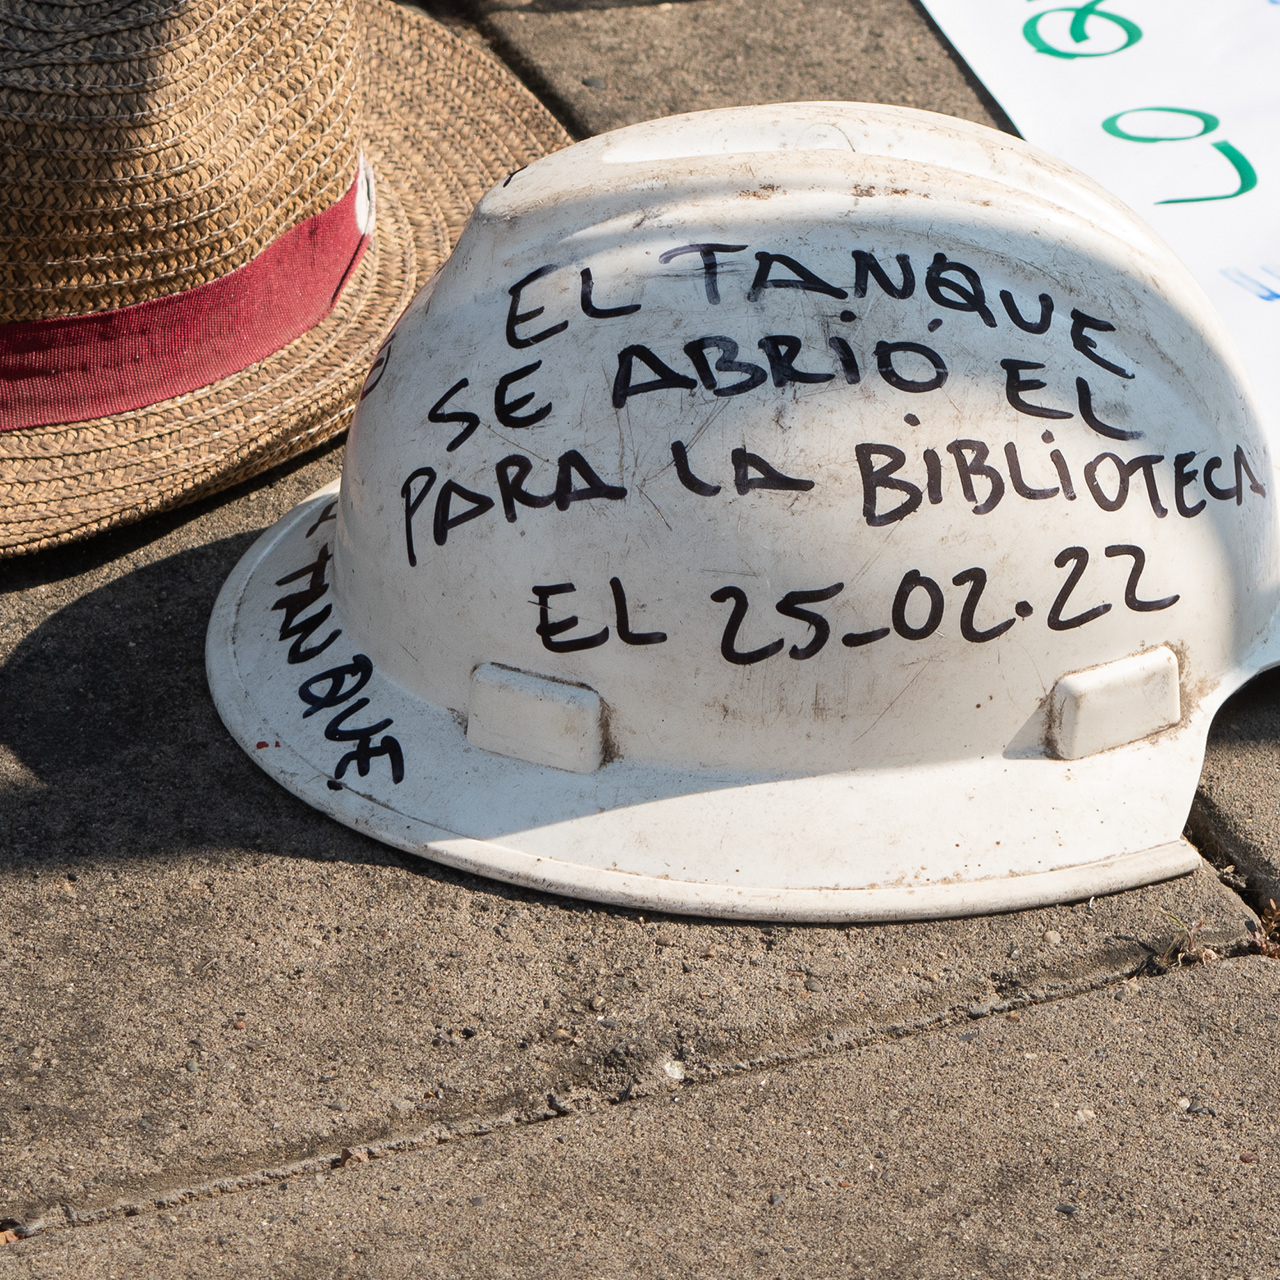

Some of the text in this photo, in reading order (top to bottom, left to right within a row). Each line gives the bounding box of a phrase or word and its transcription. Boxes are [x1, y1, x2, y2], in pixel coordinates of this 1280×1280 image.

[1100, 106, 1259, 206] LO
[504, 242, 1136, 380] EL TANQUE
[426, 359, 554, 453] SE
[999, 357, 1147, 443] EL
[400, 412, 1267, 568] PARA LA BIBLIOTECA
[531, 575, 669, 655] EL
